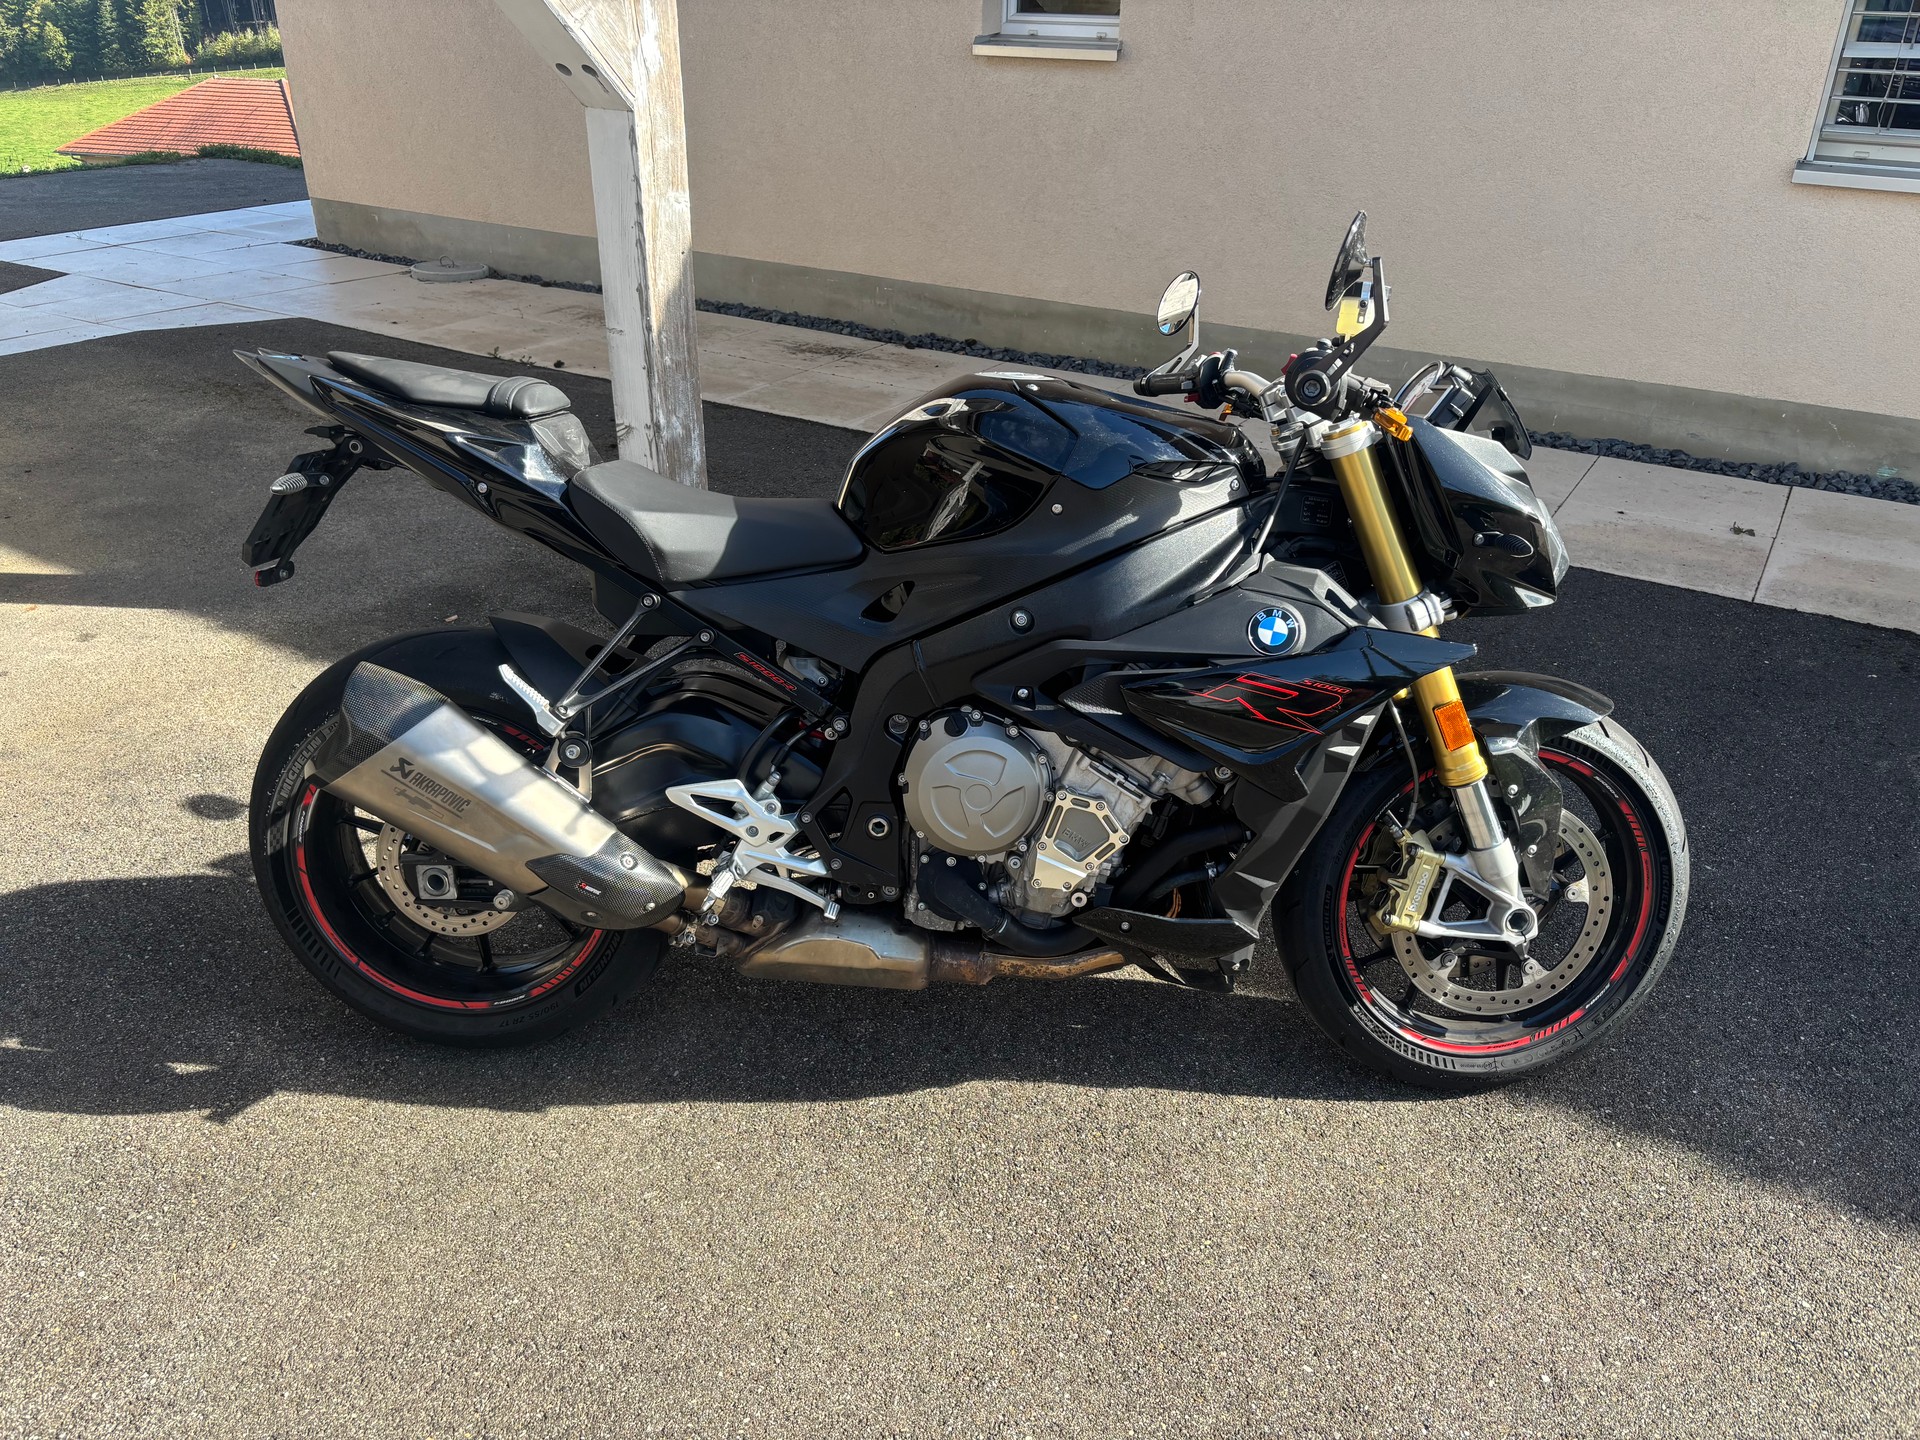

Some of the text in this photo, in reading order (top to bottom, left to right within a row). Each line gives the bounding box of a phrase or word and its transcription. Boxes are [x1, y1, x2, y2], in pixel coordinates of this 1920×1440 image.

[1256, 609, 1296, 629] BMW
[280, 736, 322, 799] MICHELIN
[409, 771, 472, 814] AKRAPOVIČ
[1062, 827, 1090, 848] BMW
[1407, 871, 1429, 912] brembo
[1658, 864, 1671, 920] MICHELIN
[1323, 888, 1334, 947] MICHELIN
[579, 931, 622, 991] MICHELIN
[1357, 1011, 1375, 1029] FRONT
